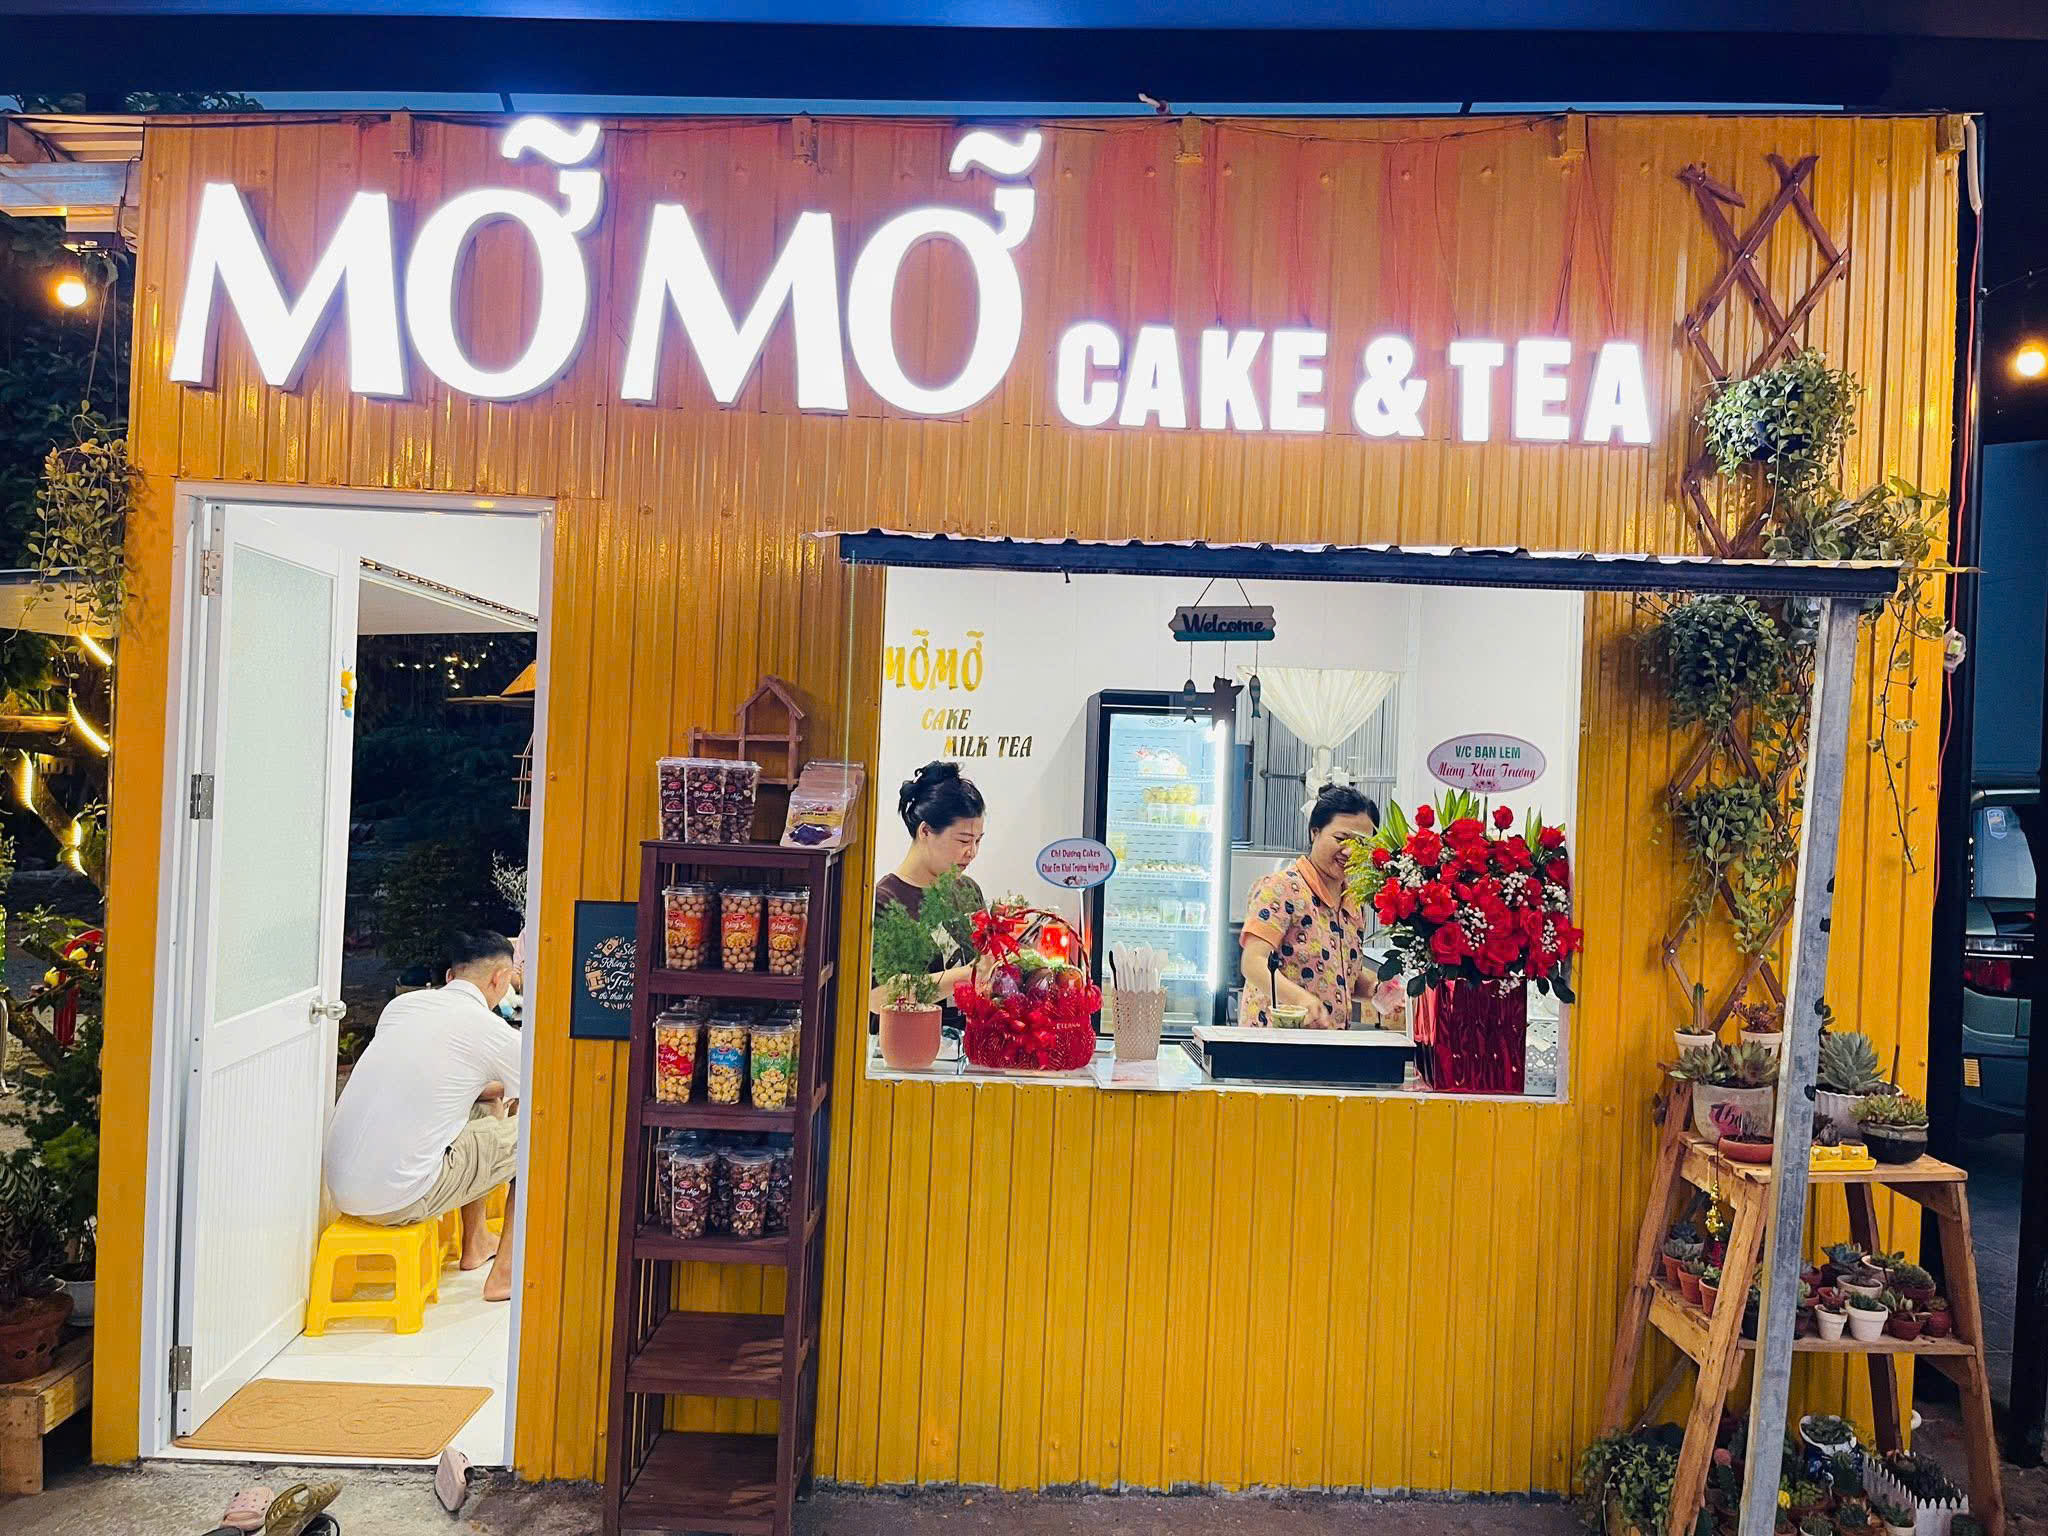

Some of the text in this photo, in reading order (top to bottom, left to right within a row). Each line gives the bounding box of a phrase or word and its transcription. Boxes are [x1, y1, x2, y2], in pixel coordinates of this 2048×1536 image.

[1057, 322, 1327, 432] CAKE
[1352, 336, 1428, 439] &
[1450, 340, 1652, 445] TEA
[1182, 613, 1266, 633] Welcome
[921, 708, 971, 731] CAKE
[944, 735, 1033, 758] MILK TEA
[1455, 745, 1521, 761] V/C BẠN LEM
[1468, 762, 1496, 778] Khai
[1082, 849, 1101, 858] Cakes
